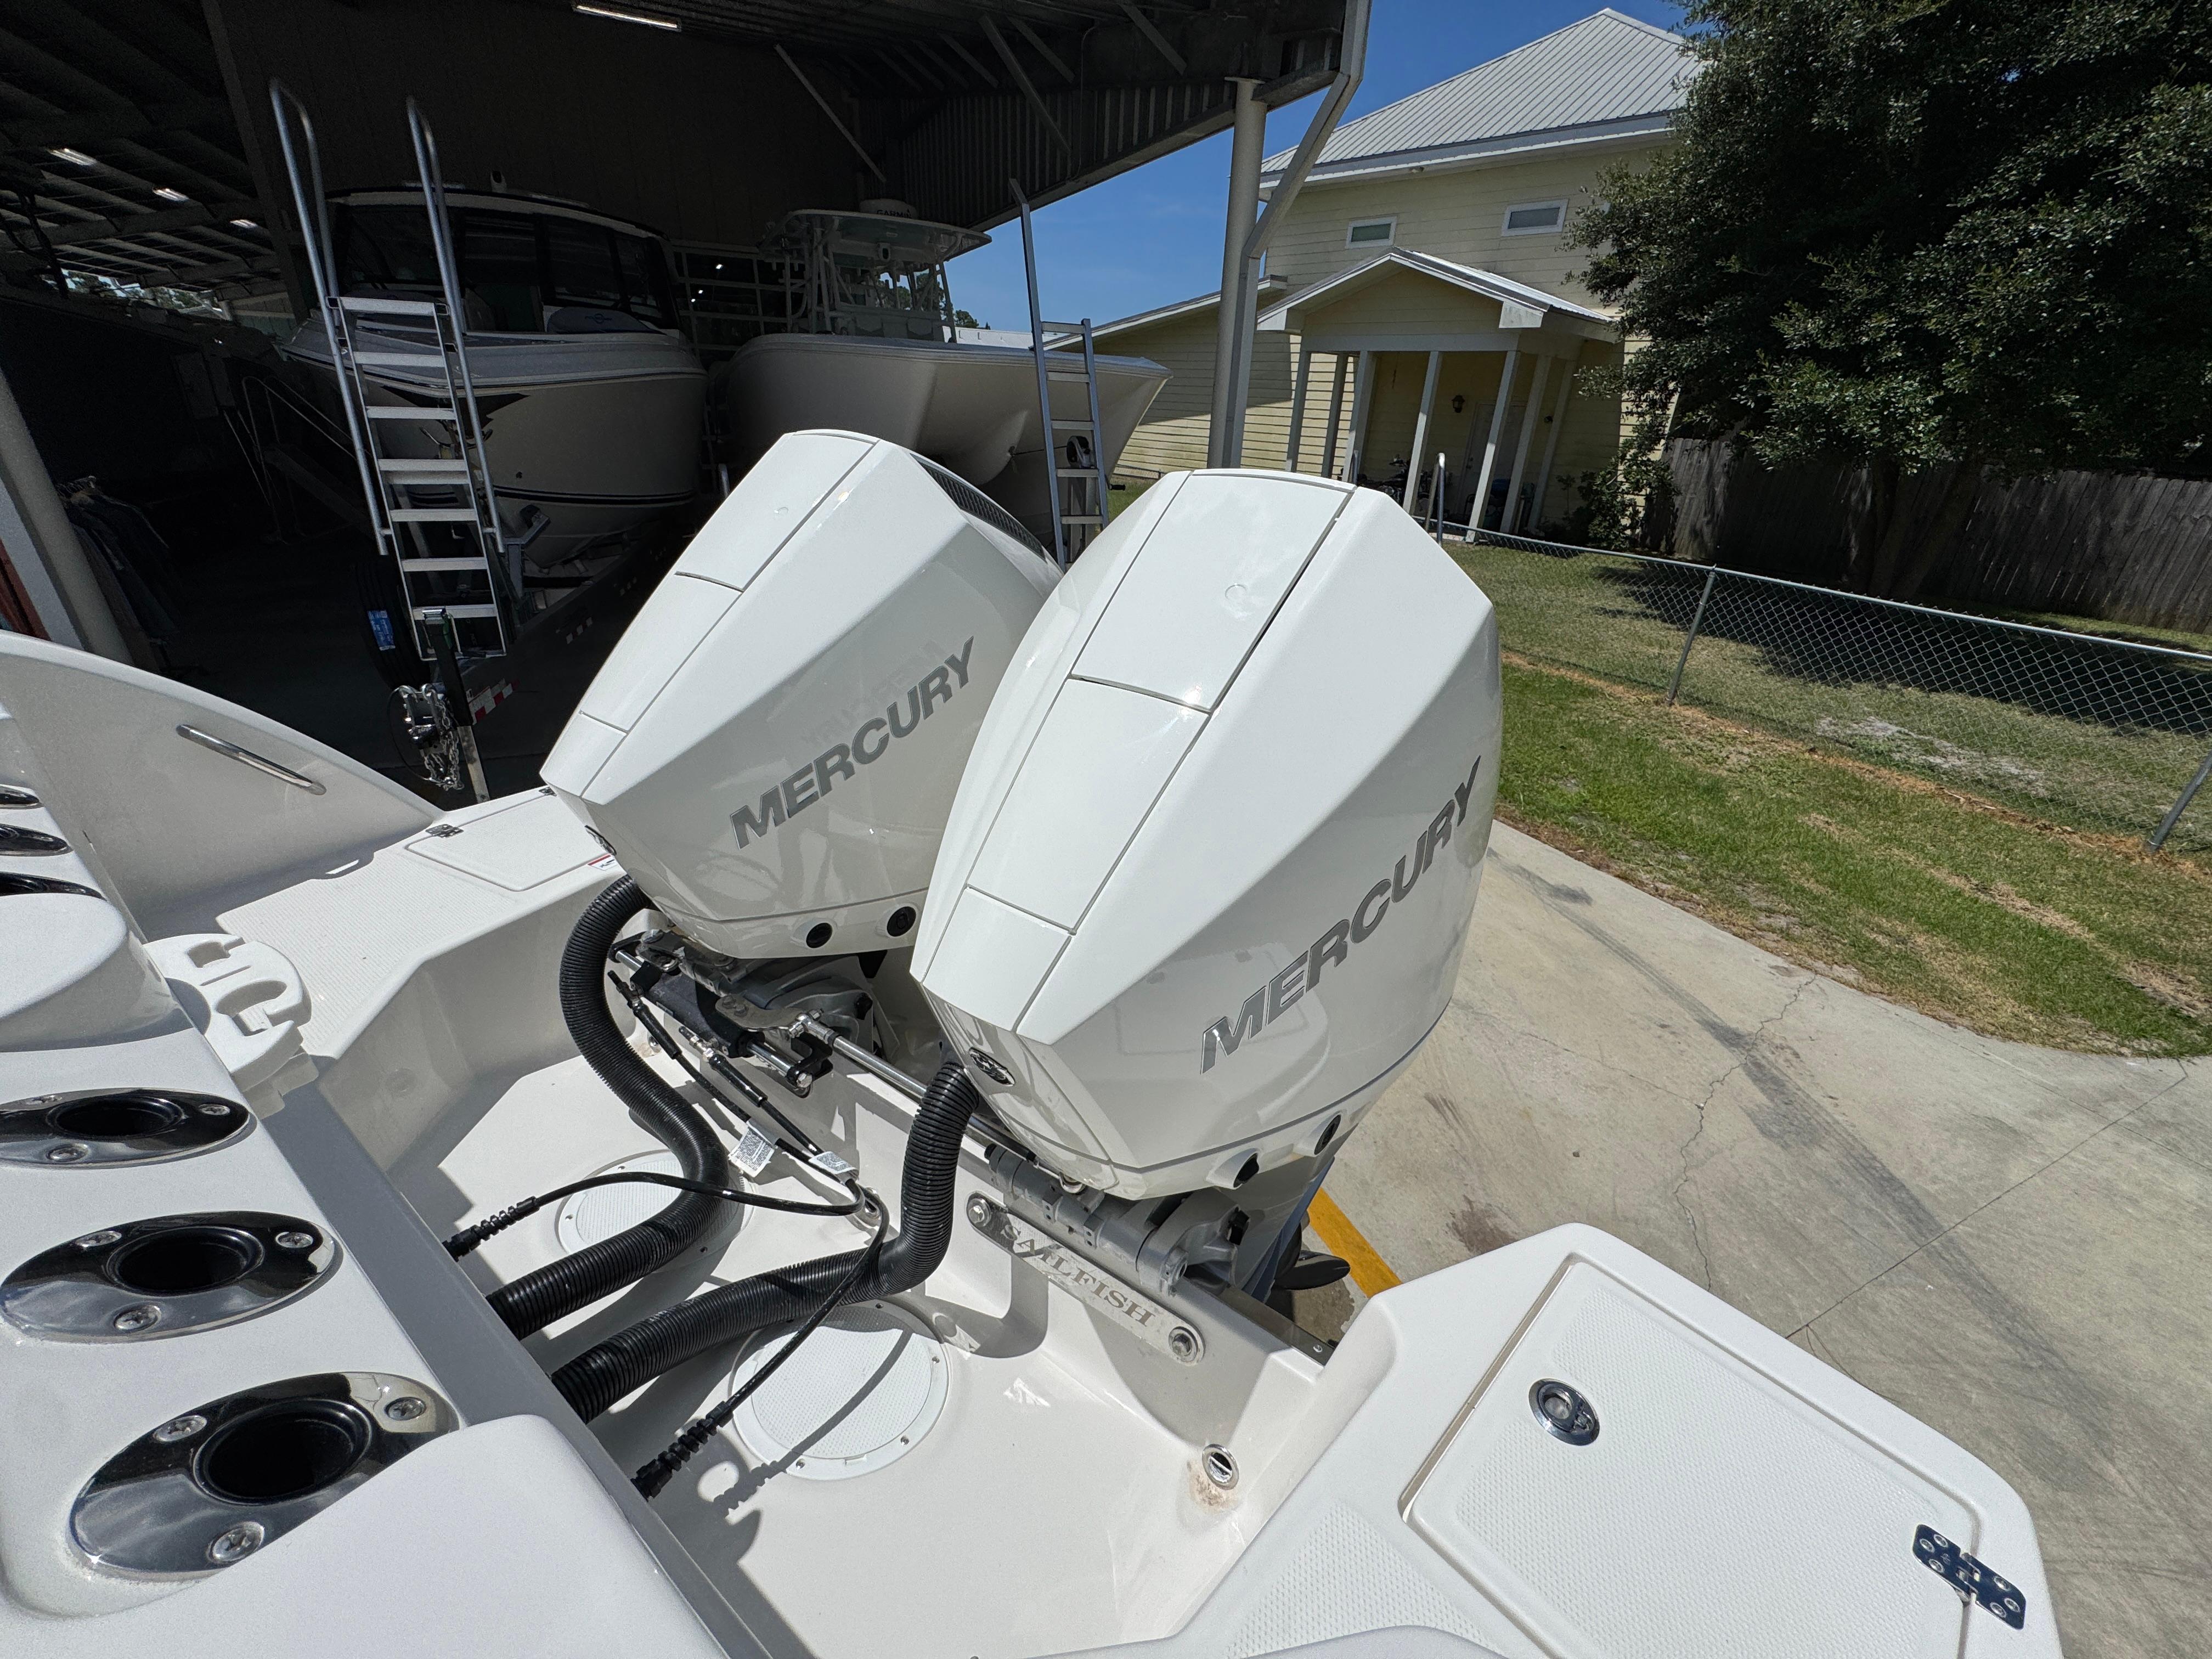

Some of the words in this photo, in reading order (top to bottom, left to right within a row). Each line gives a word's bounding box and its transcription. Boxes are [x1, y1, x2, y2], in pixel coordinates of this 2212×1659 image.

[877, 210, 912, 219] GARMIN
[730, 636, 974, 850] MERCURY
[1200, 755, 1481, 1075] MERCURY
[1000, 1223, 1155, 1327] SAILFISH
